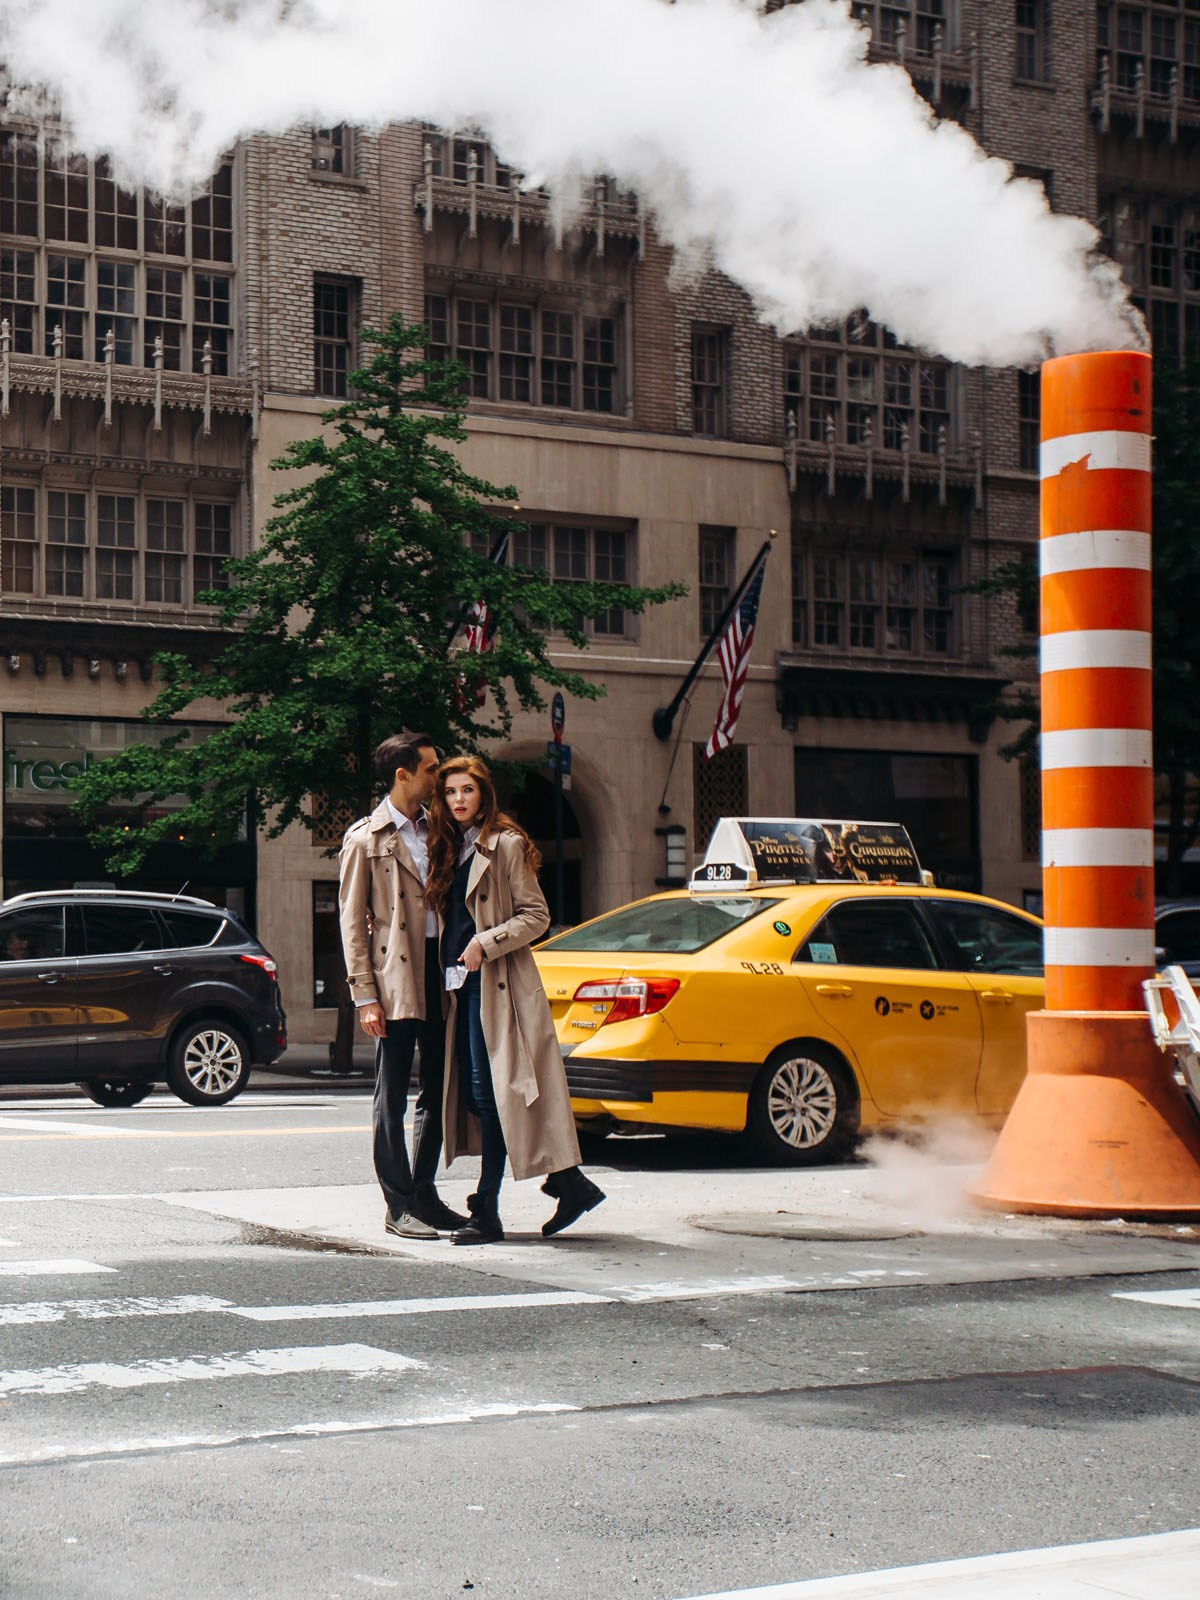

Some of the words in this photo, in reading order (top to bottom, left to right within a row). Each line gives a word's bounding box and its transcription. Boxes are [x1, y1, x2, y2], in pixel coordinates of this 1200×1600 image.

[766, 856, 789, 864] DEAD
[791, 856, 811, 865] MEN
[706, 865, 732, 880] 9L28
[740, 961, 785, 976] 9L28
